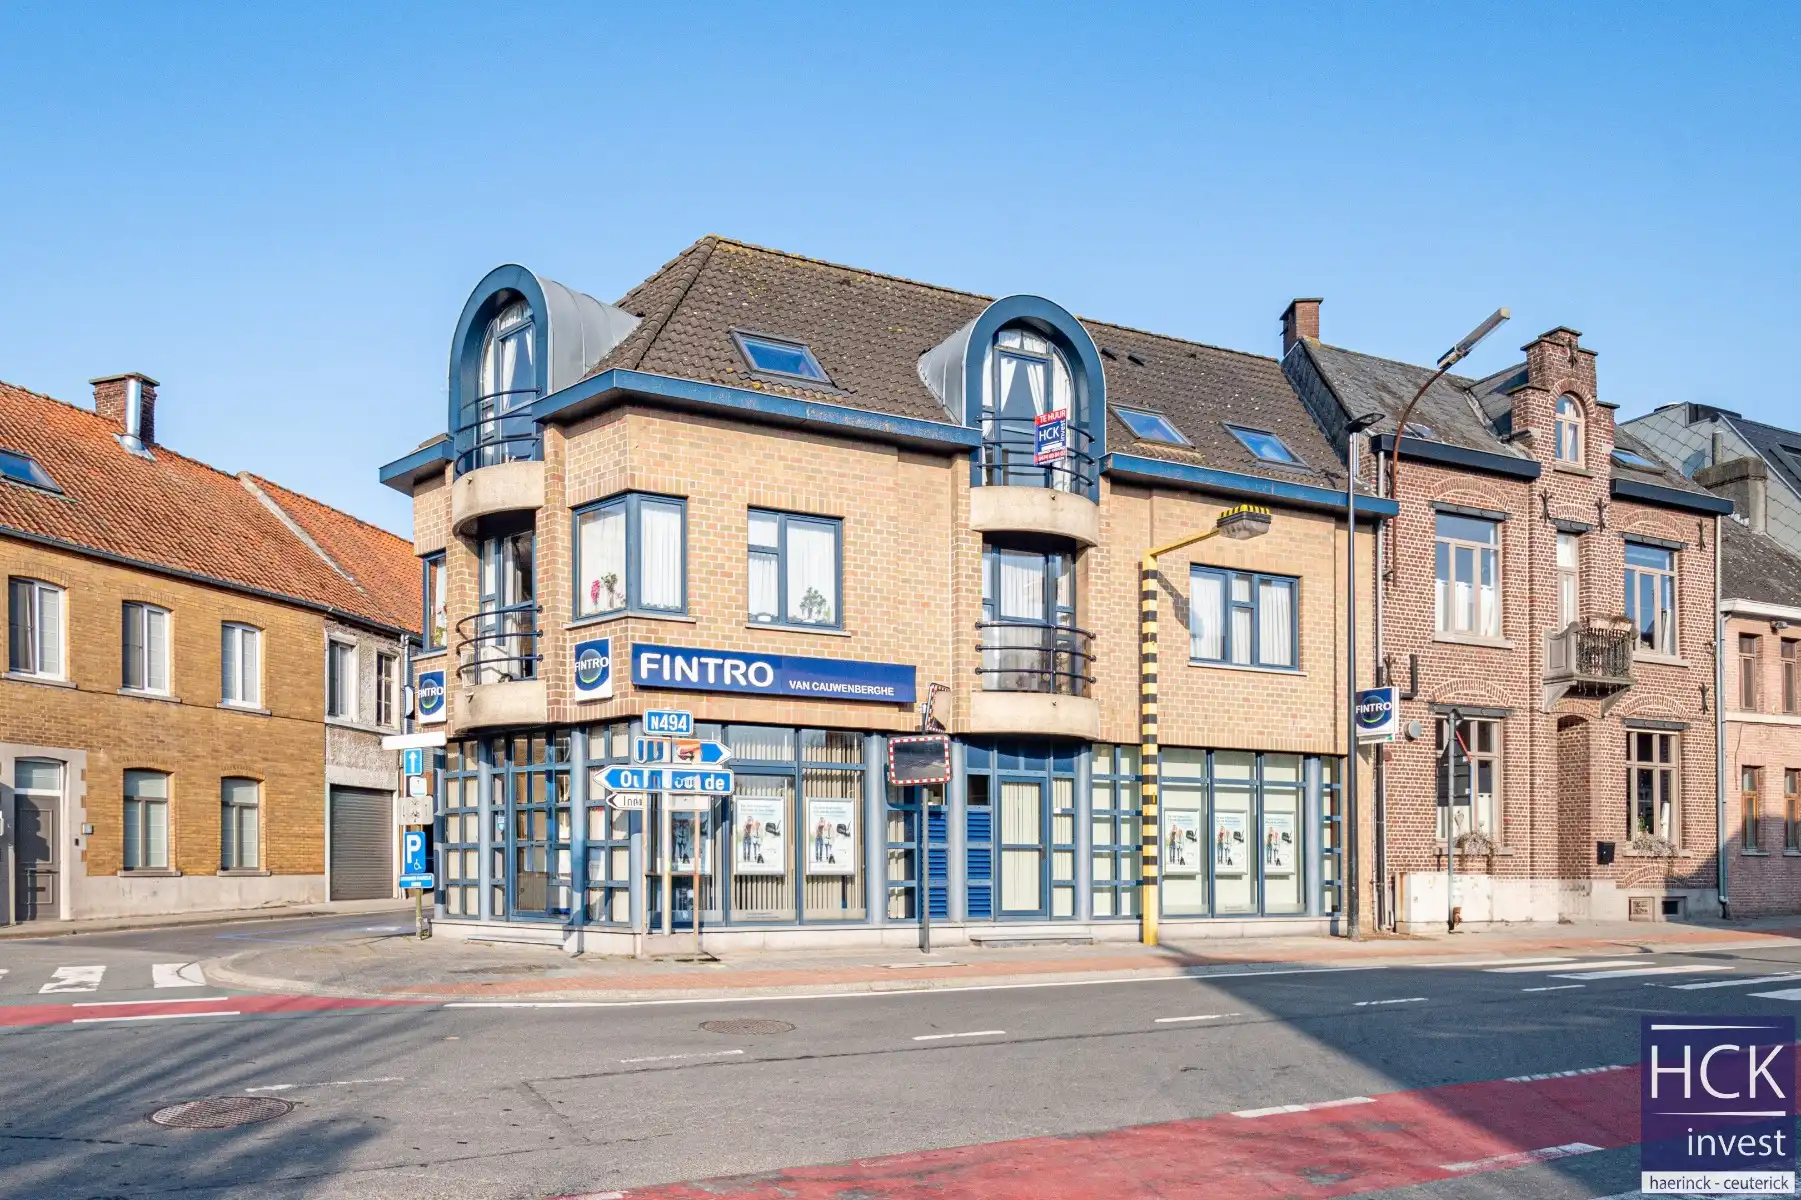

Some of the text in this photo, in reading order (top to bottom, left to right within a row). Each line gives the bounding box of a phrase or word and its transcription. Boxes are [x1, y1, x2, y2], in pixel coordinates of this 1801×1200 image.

[1040, 410, 1066, 423] TE HUUR
[1039, 426, 1060, 442] HCK
[574, 655, 610, 673] FINTRO
[640, 652, 774, 688] FINTRO
[418, 686, 444, 699] FINTRO
[789, 680, 895, 697] VAN CAUWENBERGHE
[1355, 702, 1392, 714] FINTRO
[651, 714, 688, 732] N494
[406, 834, 421, 864] P
